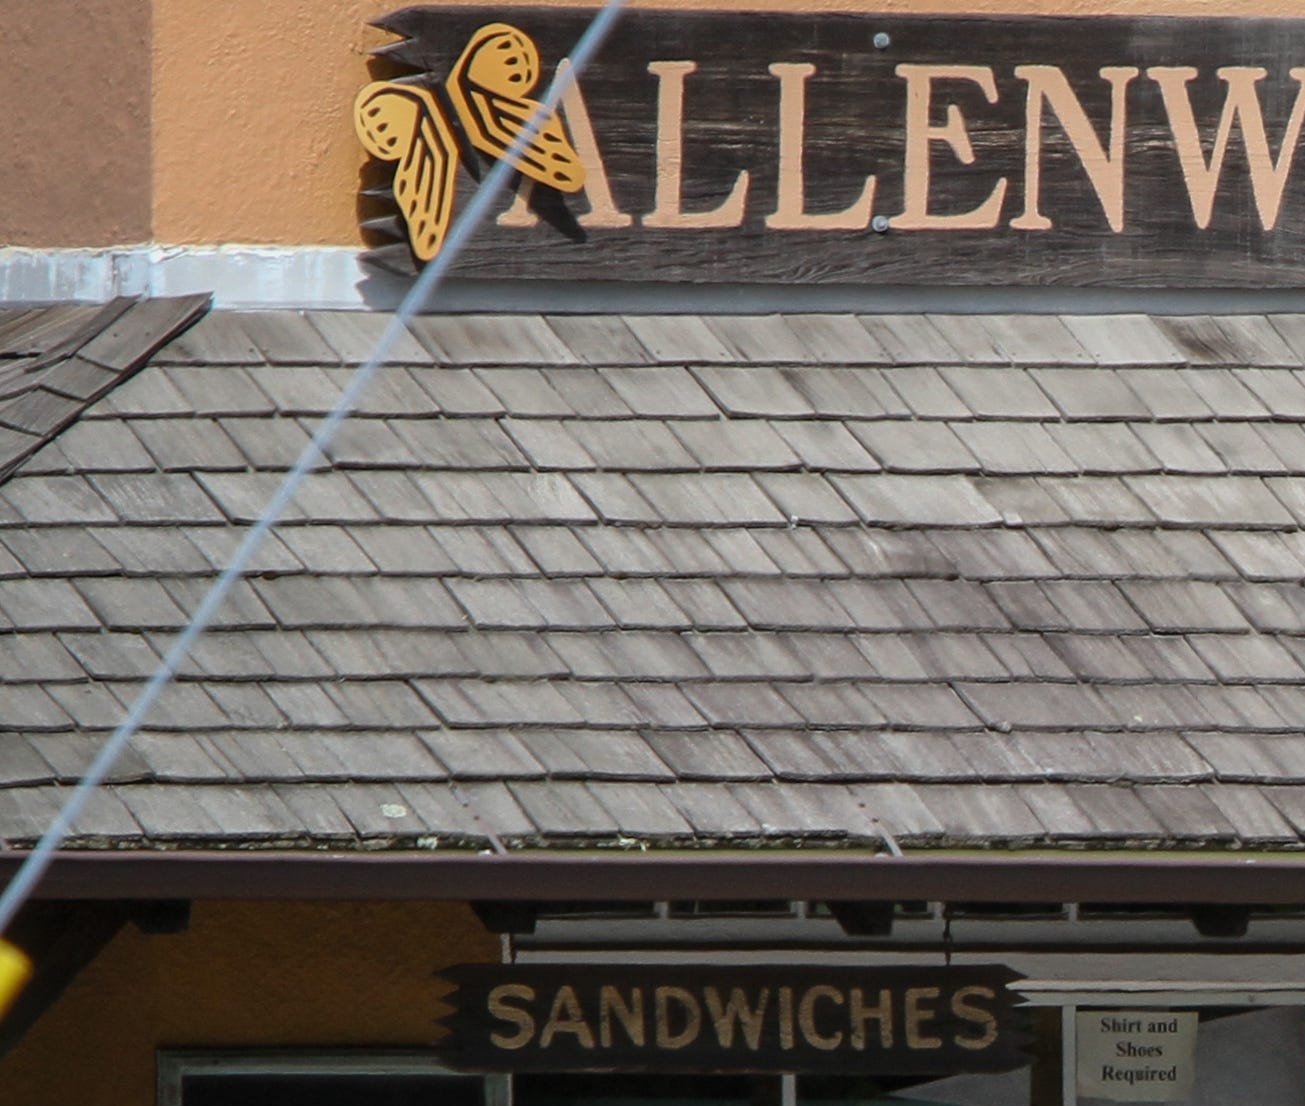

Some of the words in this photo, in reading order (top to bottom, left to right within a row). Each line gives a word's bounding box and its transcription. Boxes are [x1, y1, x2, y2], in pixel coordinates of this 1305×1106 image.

[487, 983, 999, 1051] SANDWICHES
[1100, 1017, 1142, 1033] Shirt
[1147, 1018, 1178, 1033] and
[1116, 1042, 1163, 1058] Shoes
[1101, 1065, 1177, 1085] Required
